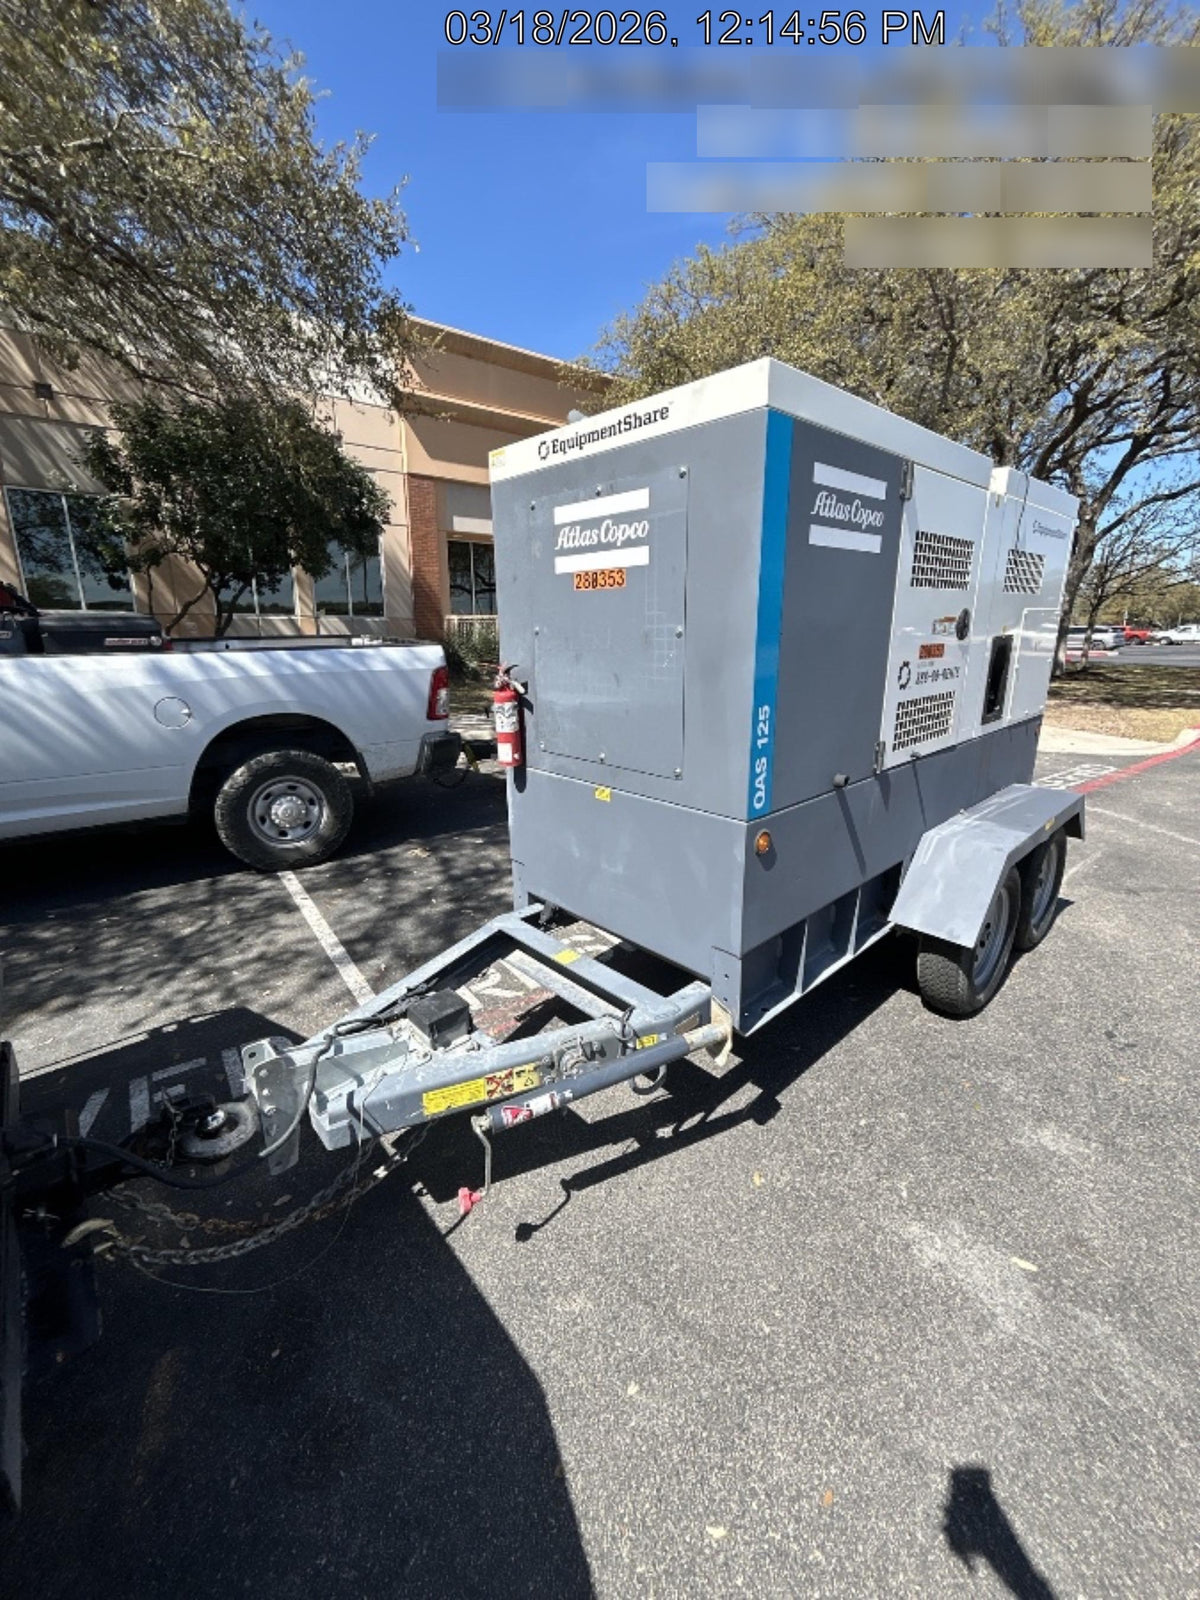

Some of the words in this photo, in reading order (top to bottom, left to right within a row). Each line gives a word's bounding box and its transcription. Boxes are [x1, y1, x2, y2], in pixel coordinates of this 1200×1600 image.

[551, 406, 669, 454] EquipmentShare
[810, 490, 851, 522] Atlas
[851, 499, 884, 530] Copco
[554, 525, 600, 551] Atlas
[600, 518, 649, 547] Copco
[757, 704, 771, 749] 125
